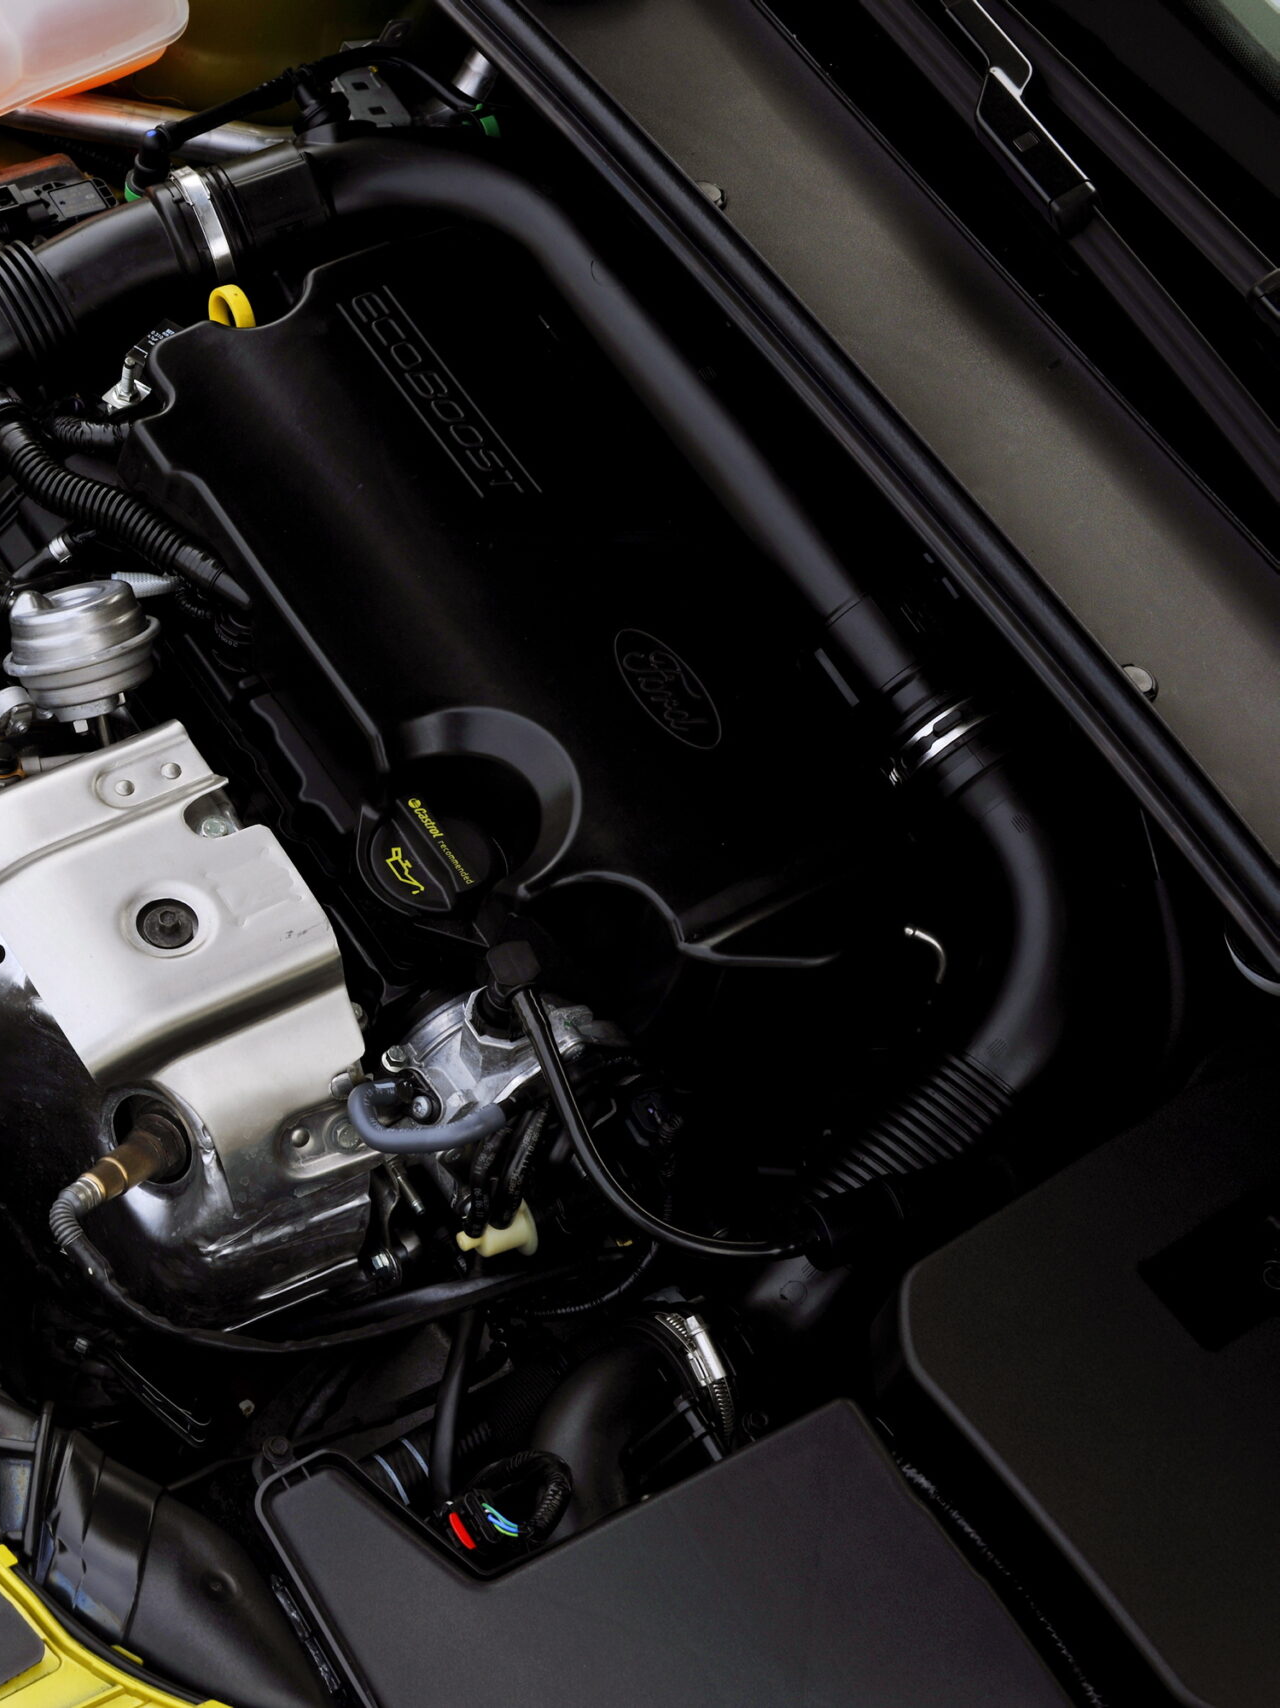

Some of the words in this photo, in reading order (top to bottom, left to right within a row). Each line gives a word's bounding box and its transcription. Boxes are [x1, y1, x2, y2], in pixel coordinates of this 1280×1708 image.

[352, 291, 524, 494] ECOBOOST
[622, 650, 710, 732] Ford
[414, 807, 443, 838] Castrol
[437, 840, 474, 884] recommended
